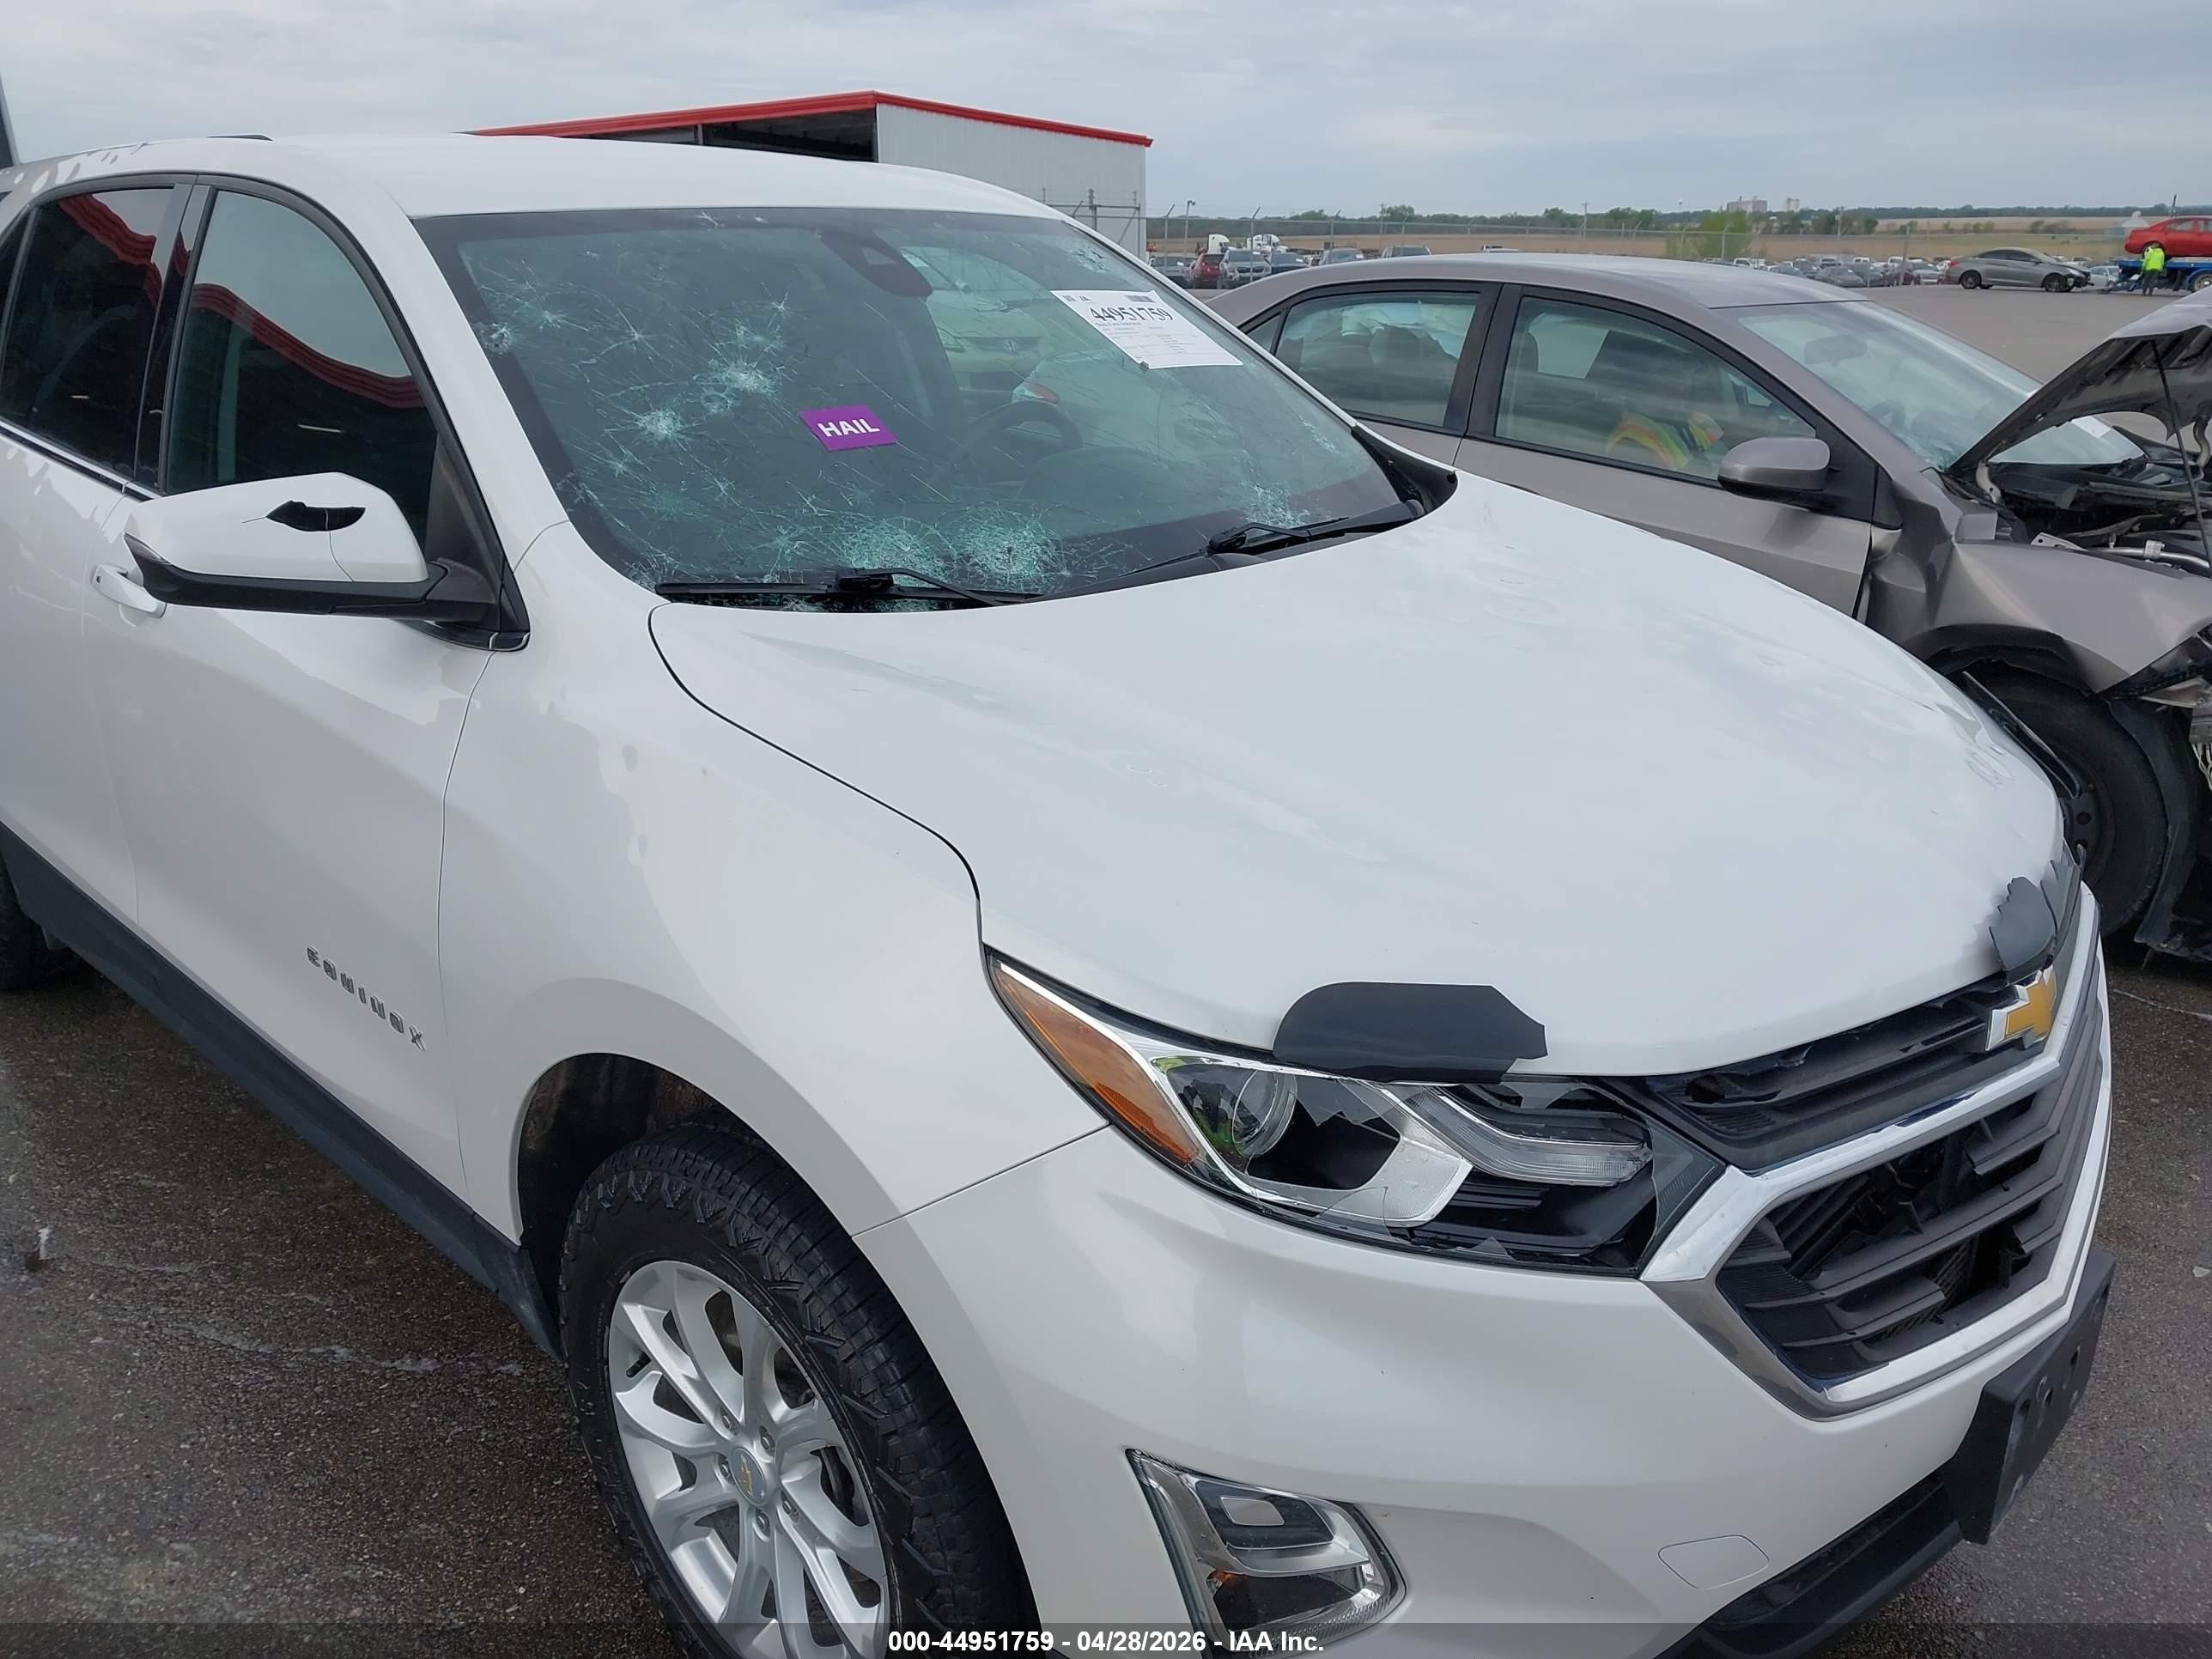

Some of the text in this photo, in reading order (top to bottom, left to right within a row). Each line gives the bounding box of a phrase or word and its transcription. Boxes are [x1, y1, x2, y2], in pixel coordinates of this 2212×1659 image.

[1090, 307, 1174, 321] 44951759
[817, 418, 880, 437] HAIL
[307, 947, 425, 1050] EQUINOX
